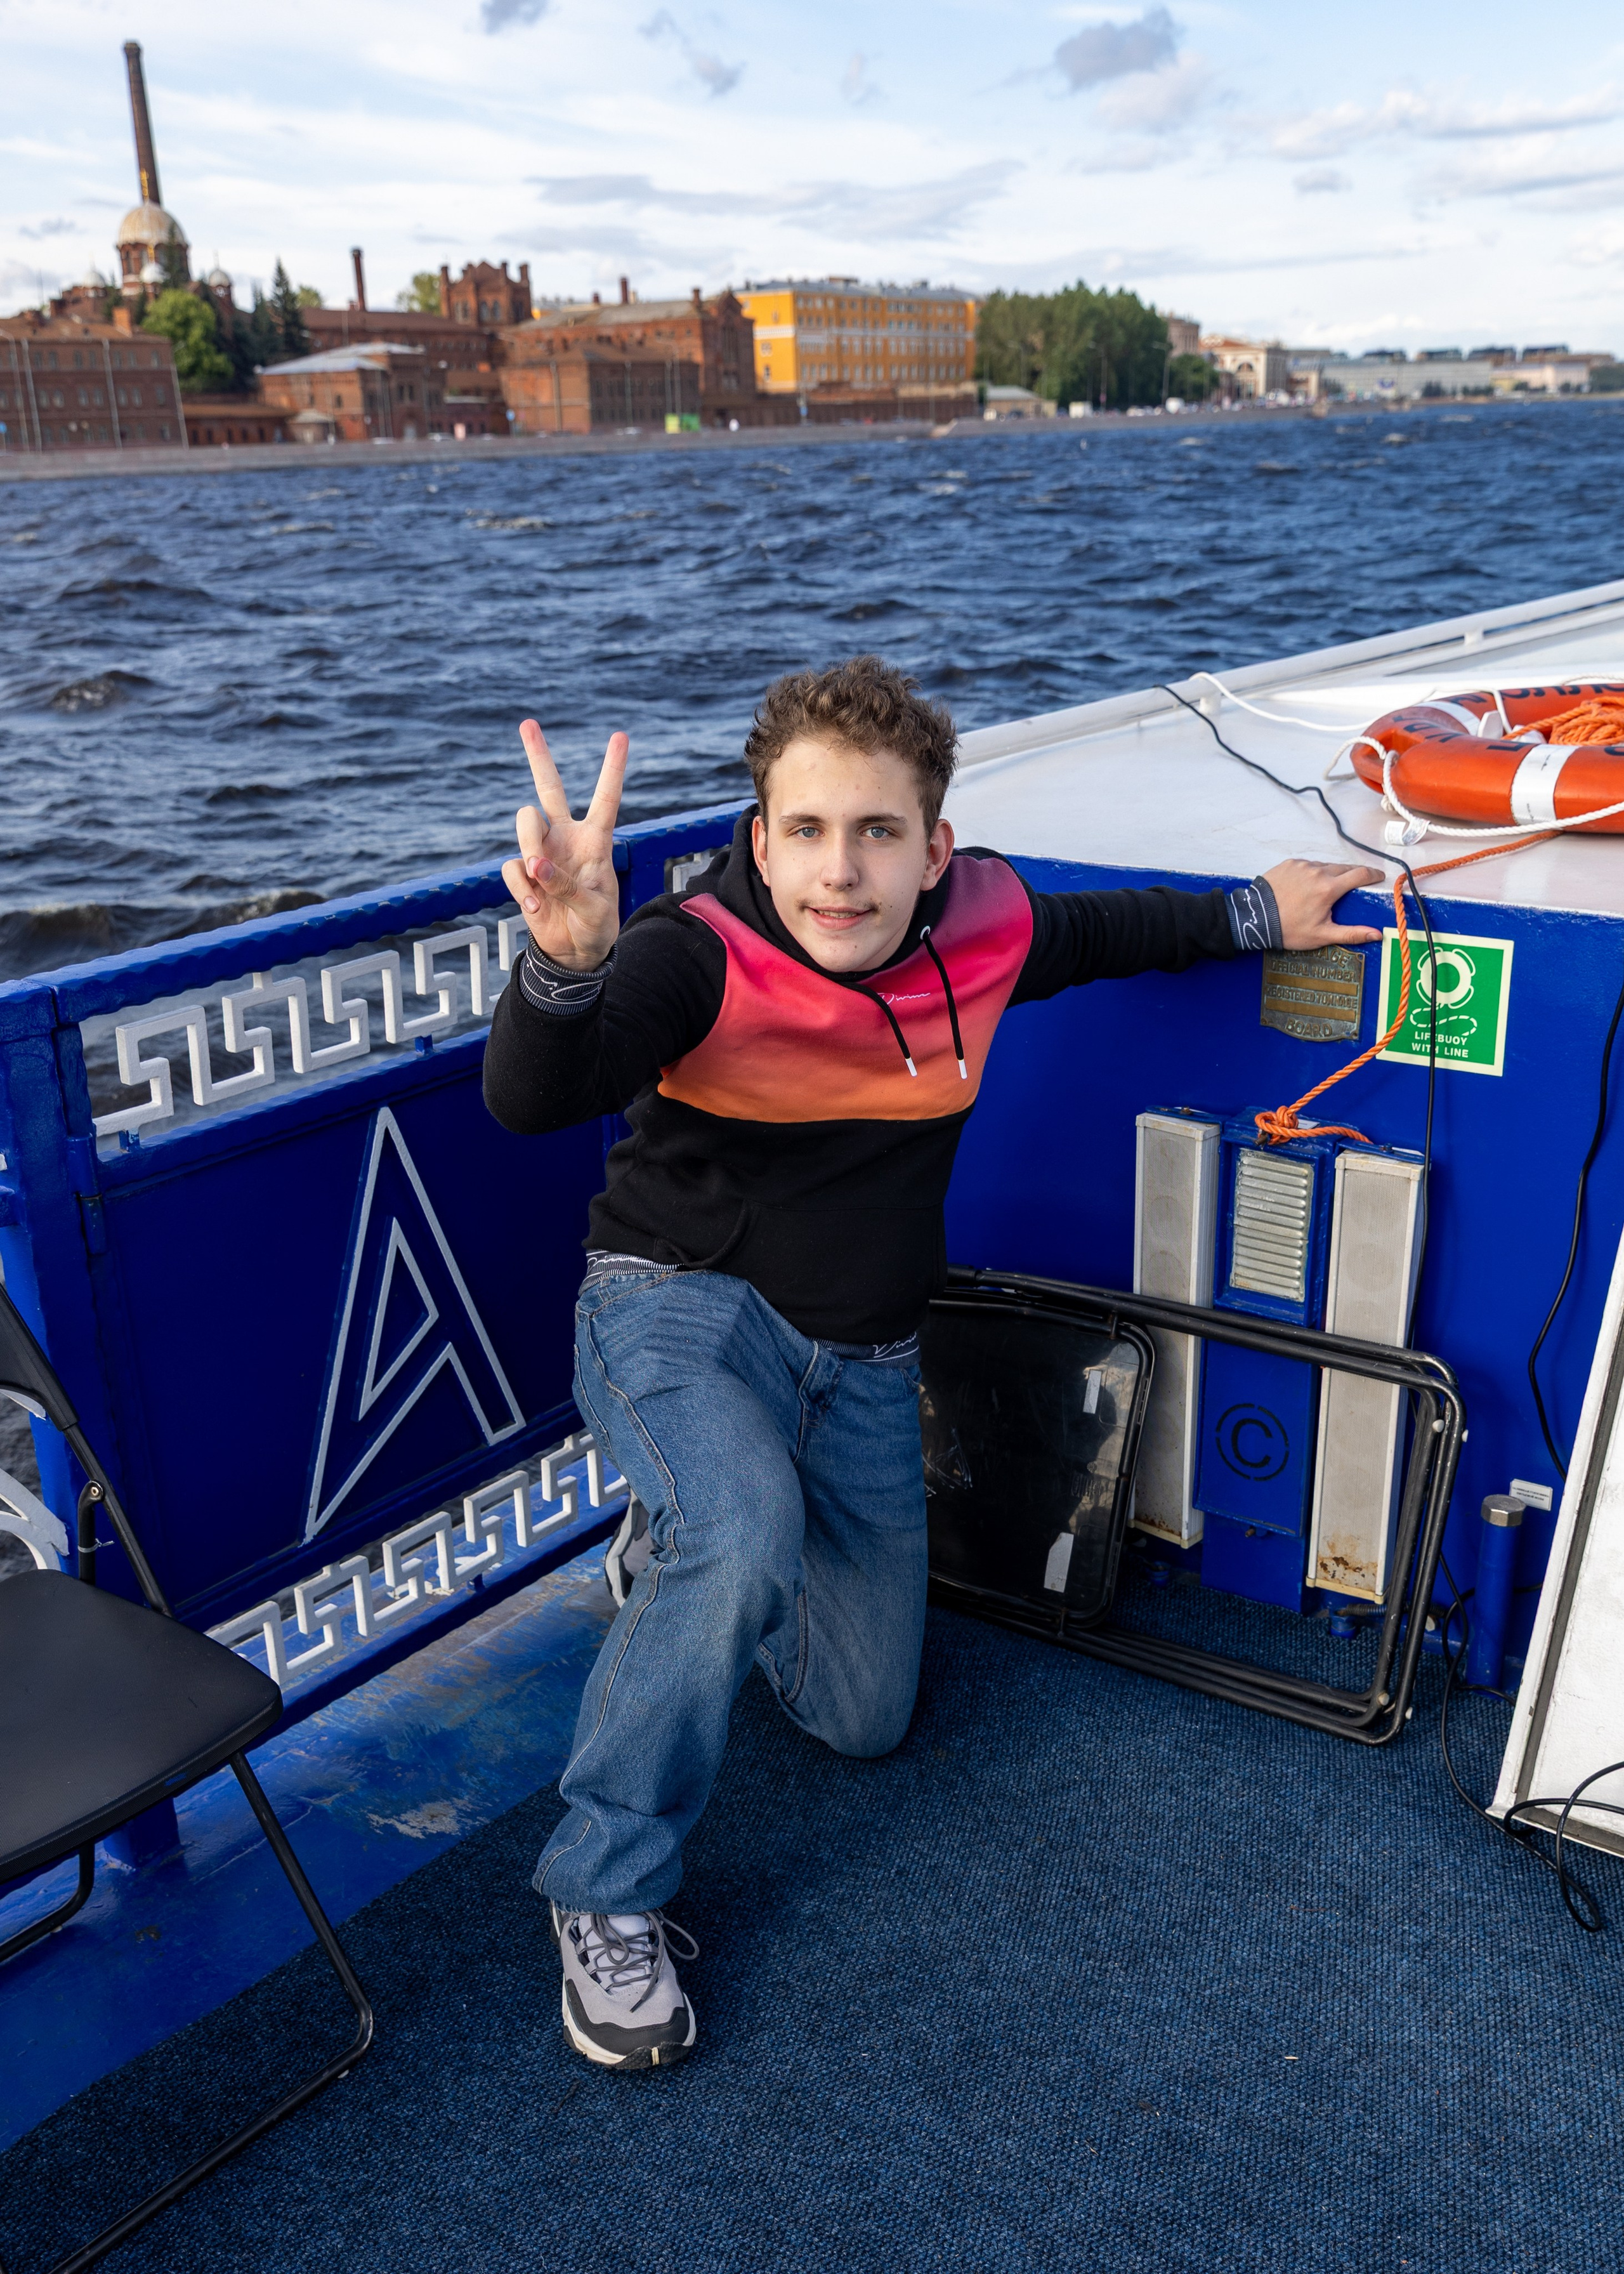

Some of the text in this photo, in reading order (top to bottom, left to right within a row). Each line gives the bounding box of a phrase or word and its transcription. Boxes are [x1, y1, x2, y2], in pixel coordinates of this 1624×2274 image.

[1271, 959, 1356, 982] OFFICIAL NUMBER
[1285, 1017, 1333, 1037] BOARD
[1414, 1031, 1467, 1046] LIFBUOY
[1444, 1047, 1469, 1058] LINE
